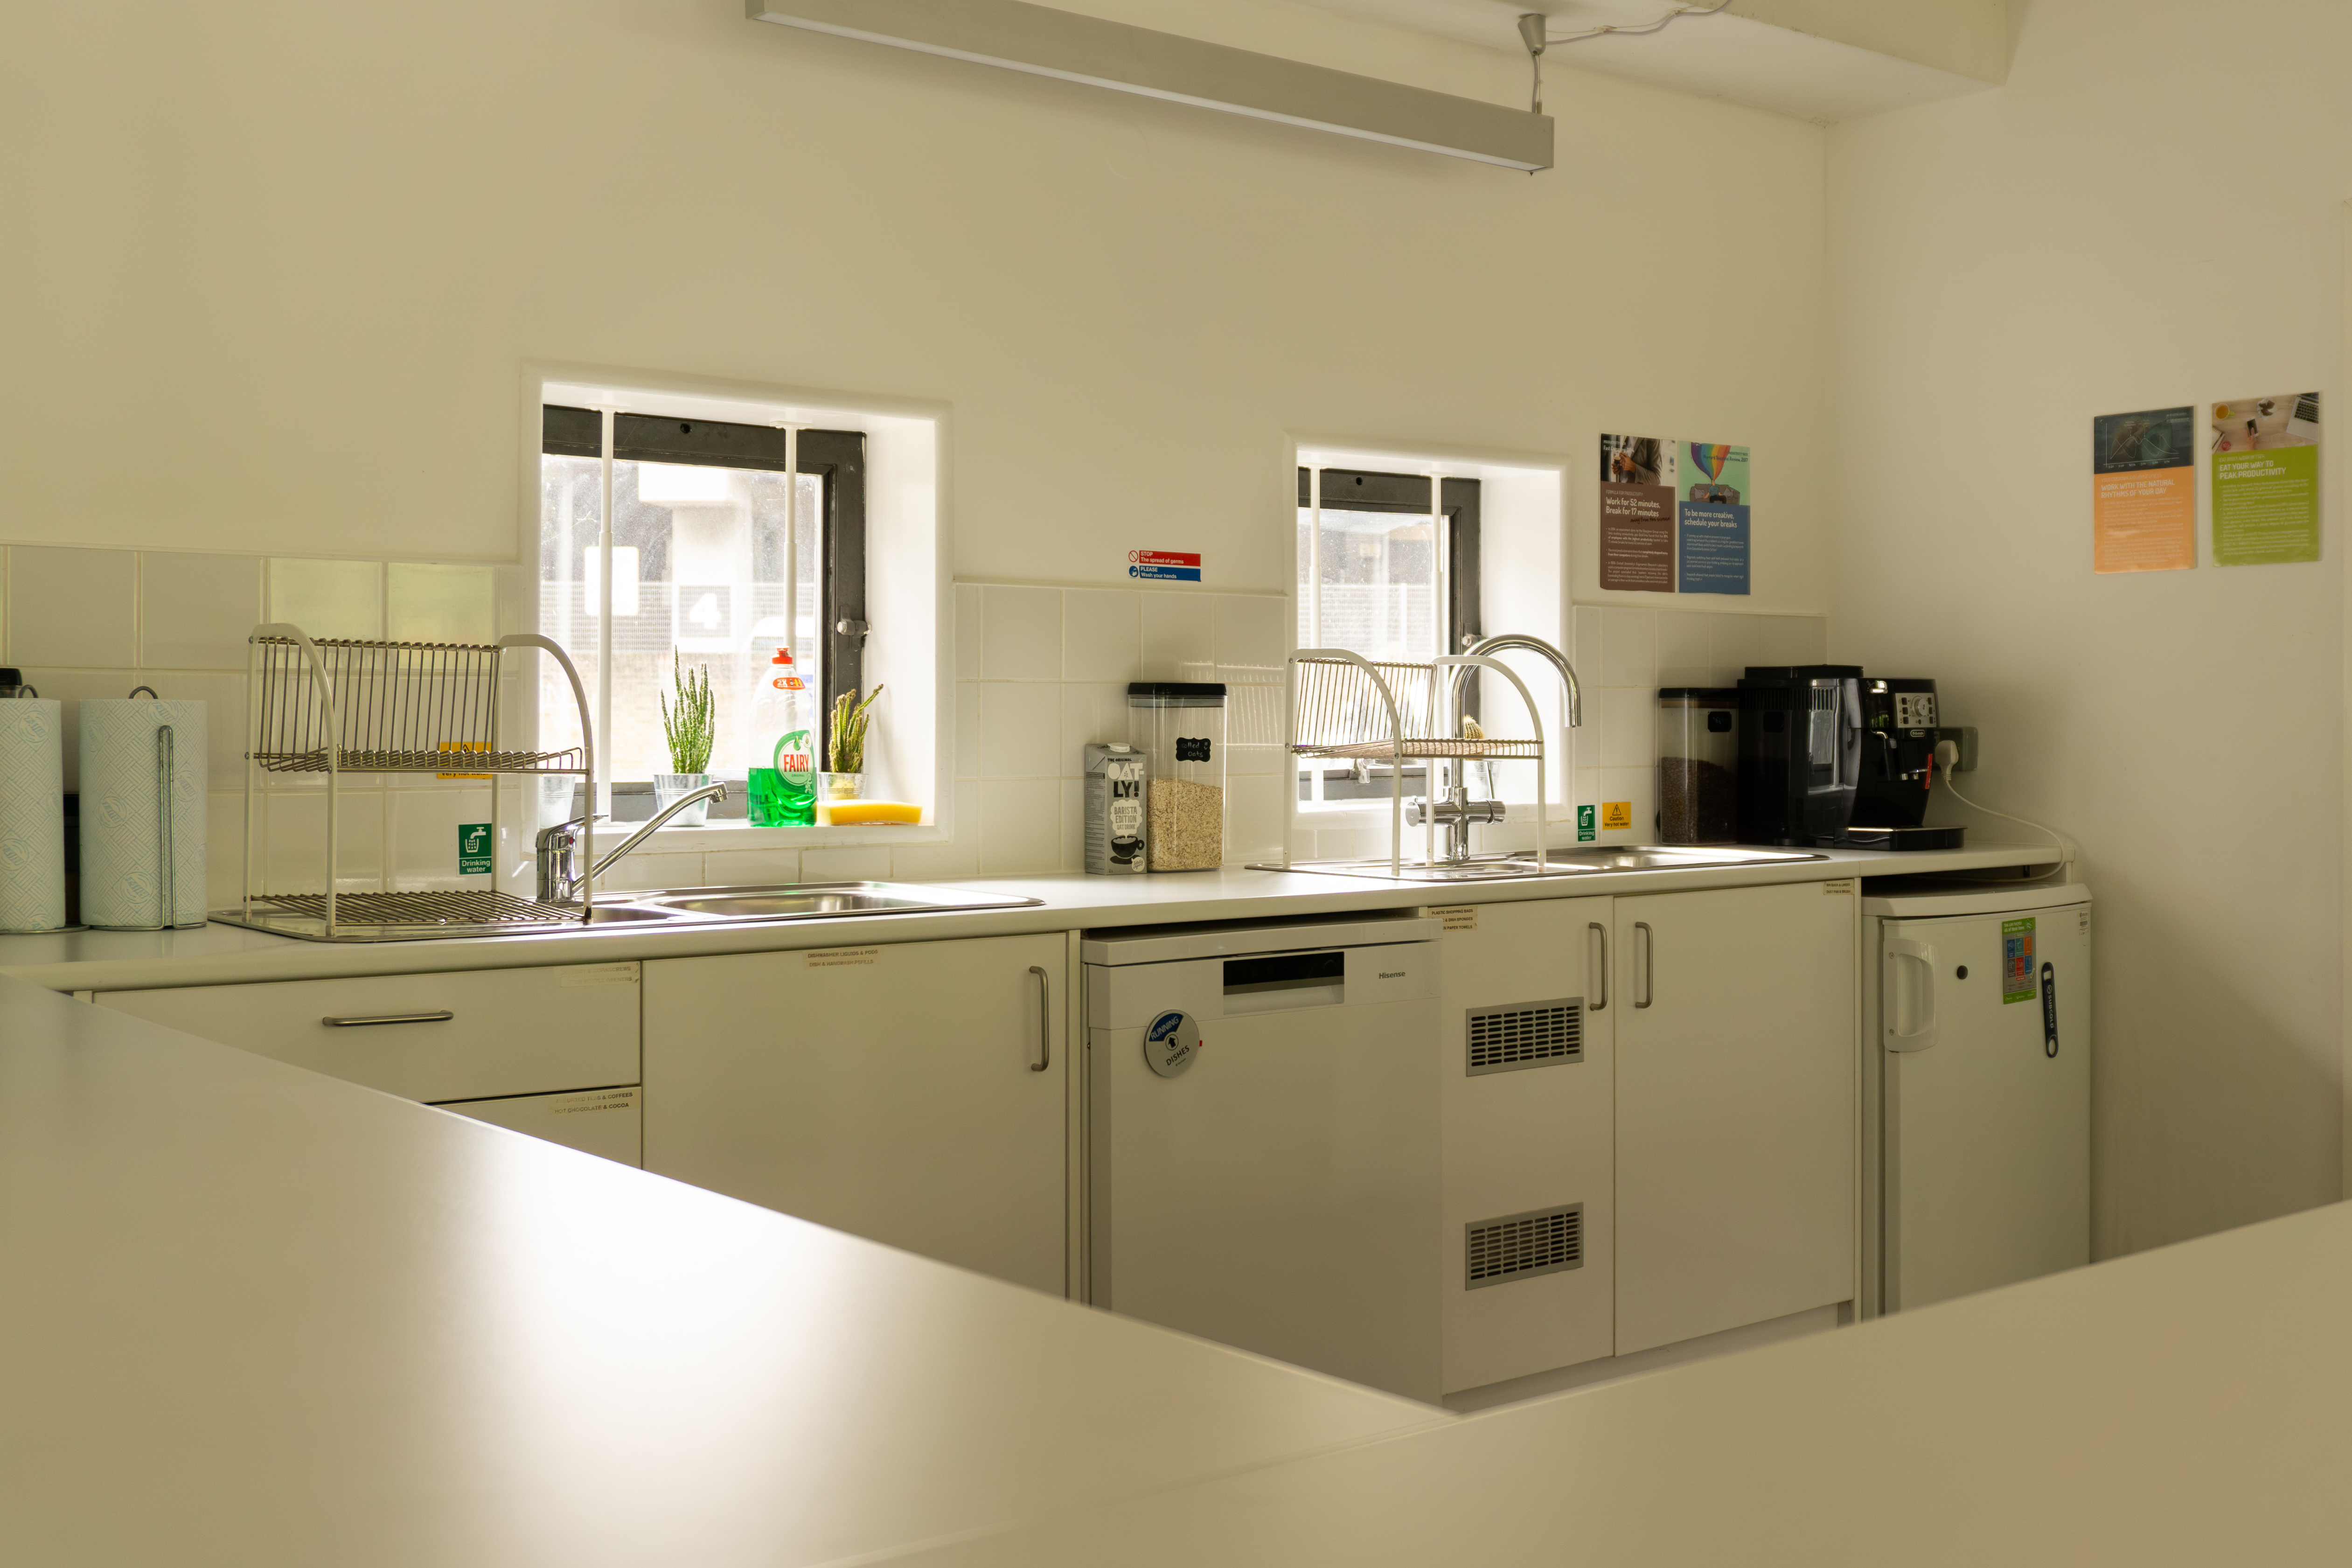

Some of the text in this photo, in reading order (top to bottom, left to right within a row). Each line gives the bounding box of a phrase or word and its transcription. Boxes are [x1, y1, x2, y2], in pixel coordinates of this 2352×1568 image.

[2238, 467, 2286, 478] PRODUCTIVITY
[1606, 496, 1621, 505] Work
[1638, 500, 1661, 509] minutes,
[1606, 506, 1621, 514] Break
[1684, 517, 1707, 526] schedule
[1720, 520, 1737, 528] breaks
[689, 593, 721, 629] 4
[784, 754, 809, 772] FAIRY
[1113, 781, 1140, 798] LY!
[1114, 806, 1137, 815] BARISTA
[1115, 815, 1137, 823] EDITION
[1150, 1016, 1179, 1040] RUNNING
[1166, 1045, 1190, 1066] DISHES
[568, 1105, 602, 1113] CHOCOLATE
